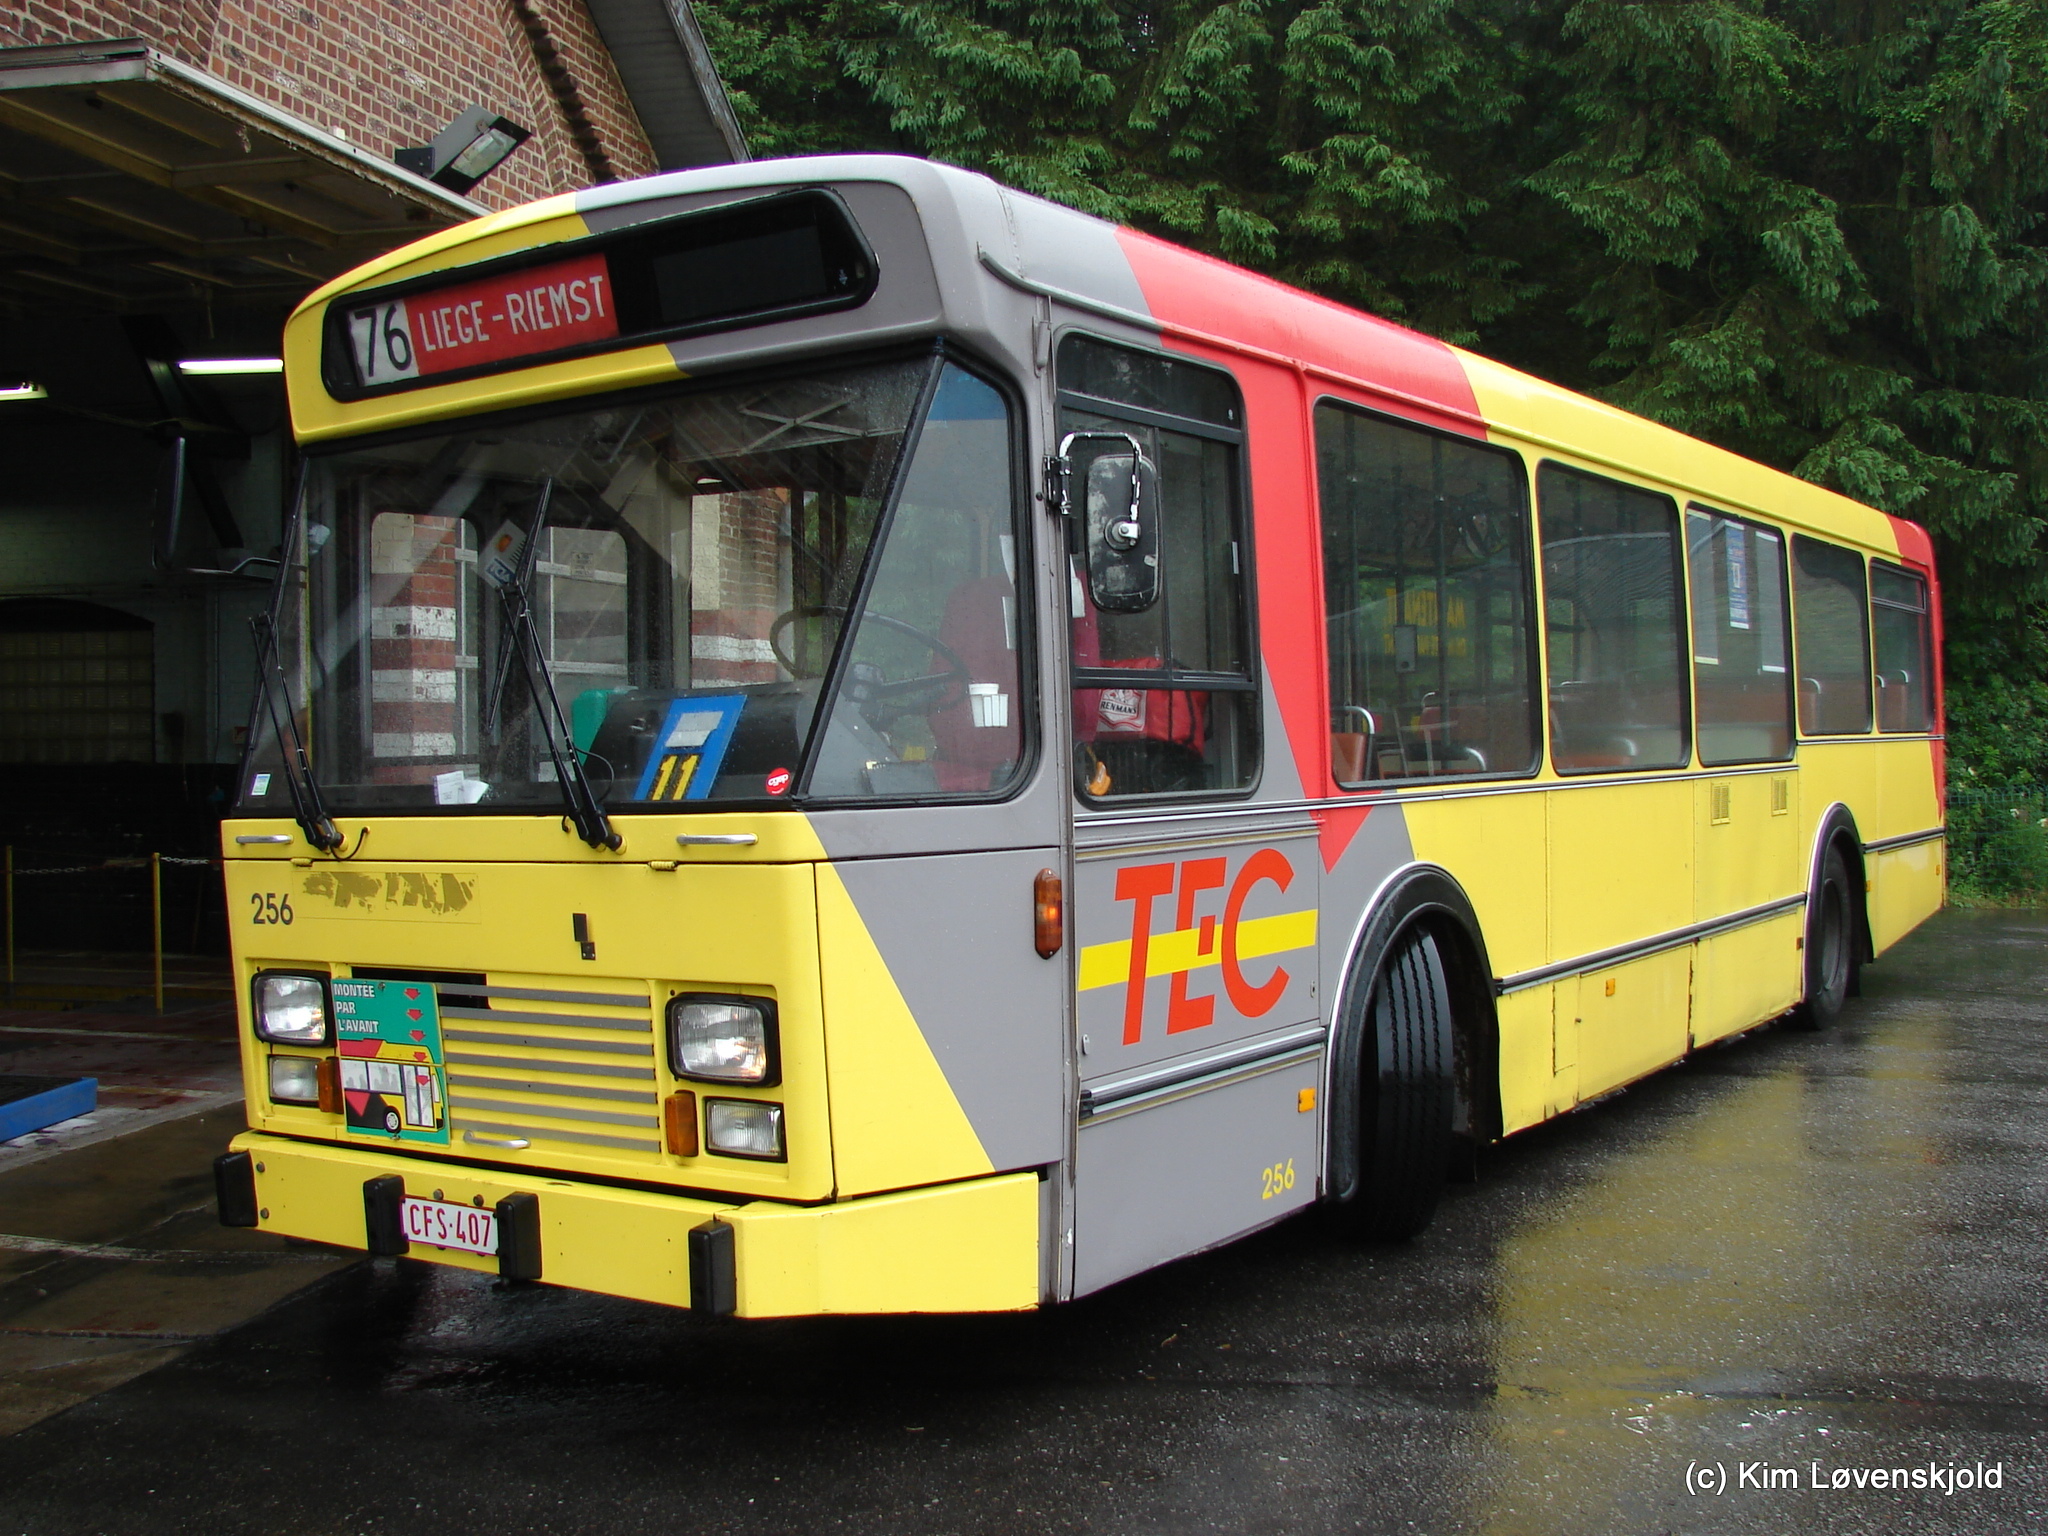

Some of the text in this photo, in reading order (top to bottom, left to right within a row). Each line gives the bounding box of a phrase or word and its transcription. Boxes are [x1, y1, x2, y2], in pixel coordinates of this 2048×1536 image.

[354, 303, 413, 378] 76
[1100, 700, 1137, 714] RENMANS
[651, 755, 699, 801] 11
[250, 892, 295, 926] 256
[1114, 847, 1295, 1046] TEC
[335, 1000, 357, 1015] PAR
[337, 1018, 380, 1034] L'AVANT
[1261, 1157, 1295, 1200] 256
